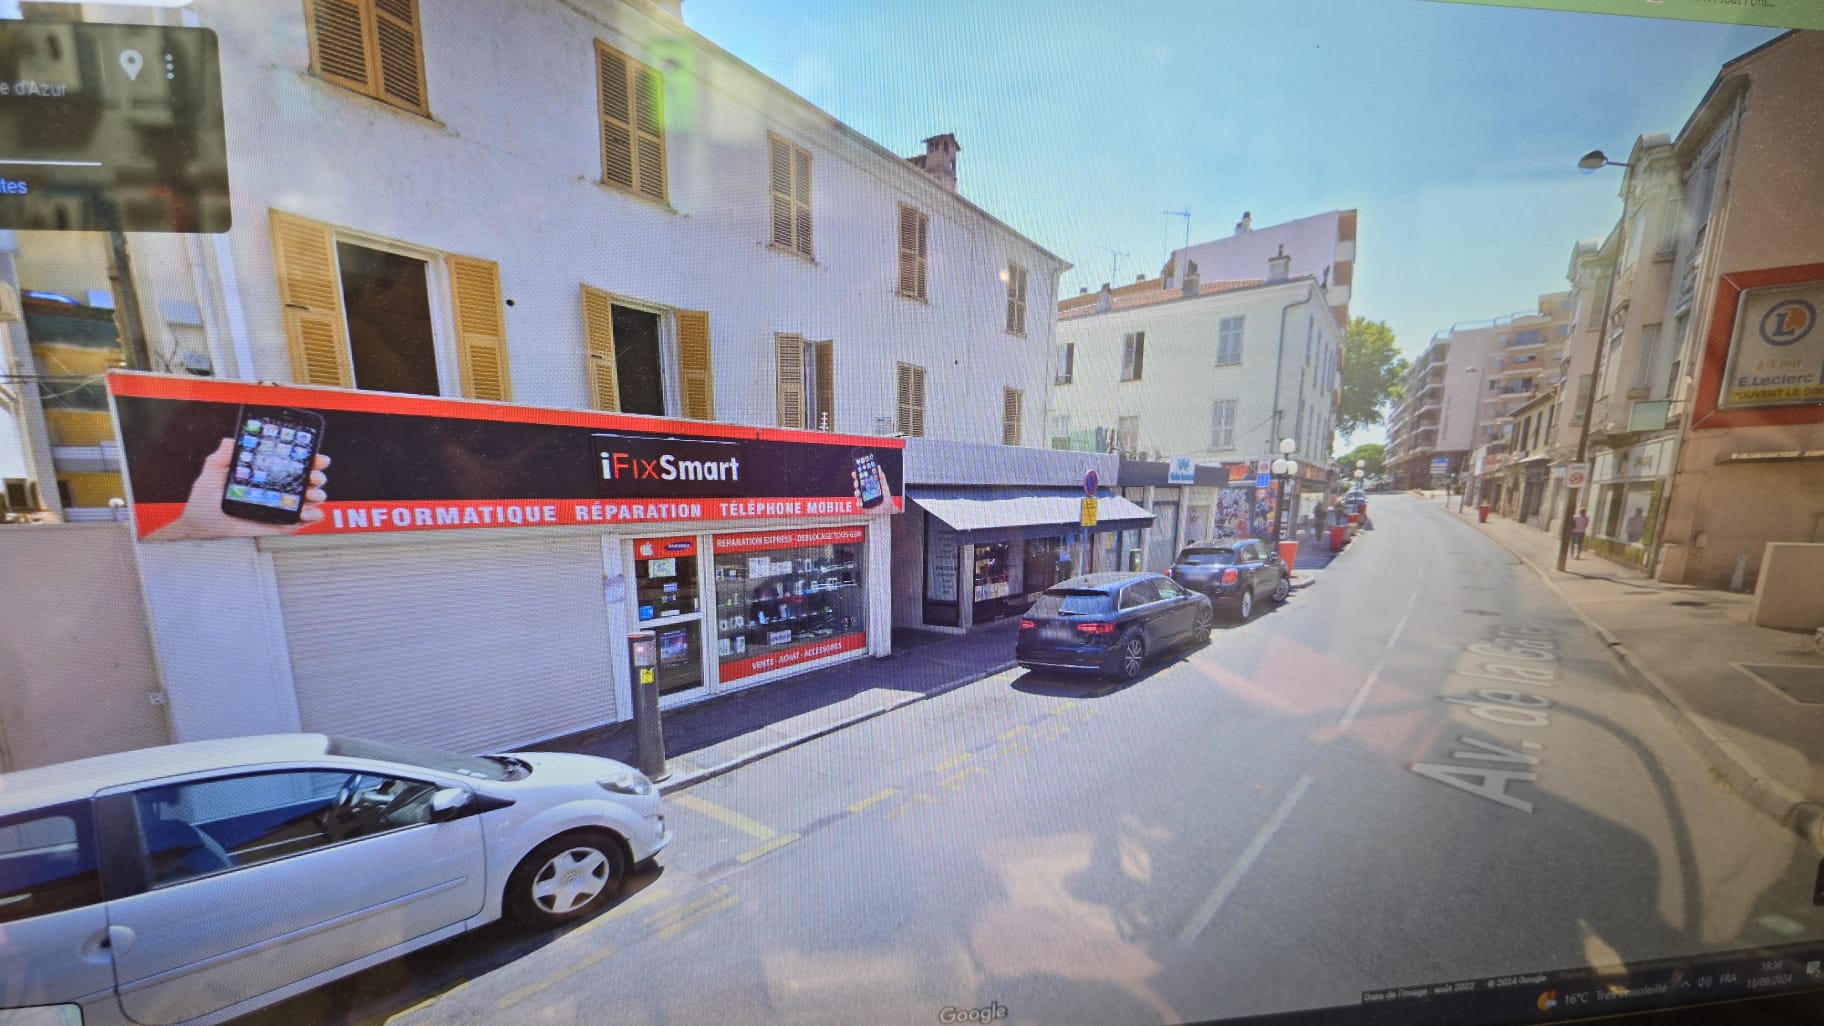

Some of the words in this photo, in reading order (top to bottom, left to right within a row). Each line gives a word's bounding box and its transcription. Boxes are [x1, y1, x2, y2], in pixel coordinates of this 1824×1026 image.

[1738, 374, 1813, 387] E.Leclerc
[333, 505, 557, 528] INFORMATIQUE
[575, 502, 701, 521] RÉPARATION
[720, 500, 801, 517] TÉLÉPHONE
[806, 501, 853, 515] MOBILE
[751, 658, 775, 670] VENTE
[778, 651, 800, 664] ACHAT
[1440, 689, 1552, 727] de
[1410, 736, 1544, 813] Av.
[1518, 975, 1547, 984] Google
[1719, 973, 1737, 985] FRA
[1564, 991, 1589, 1005] 16°C
[939, 1001, 1008, 1024] Google
